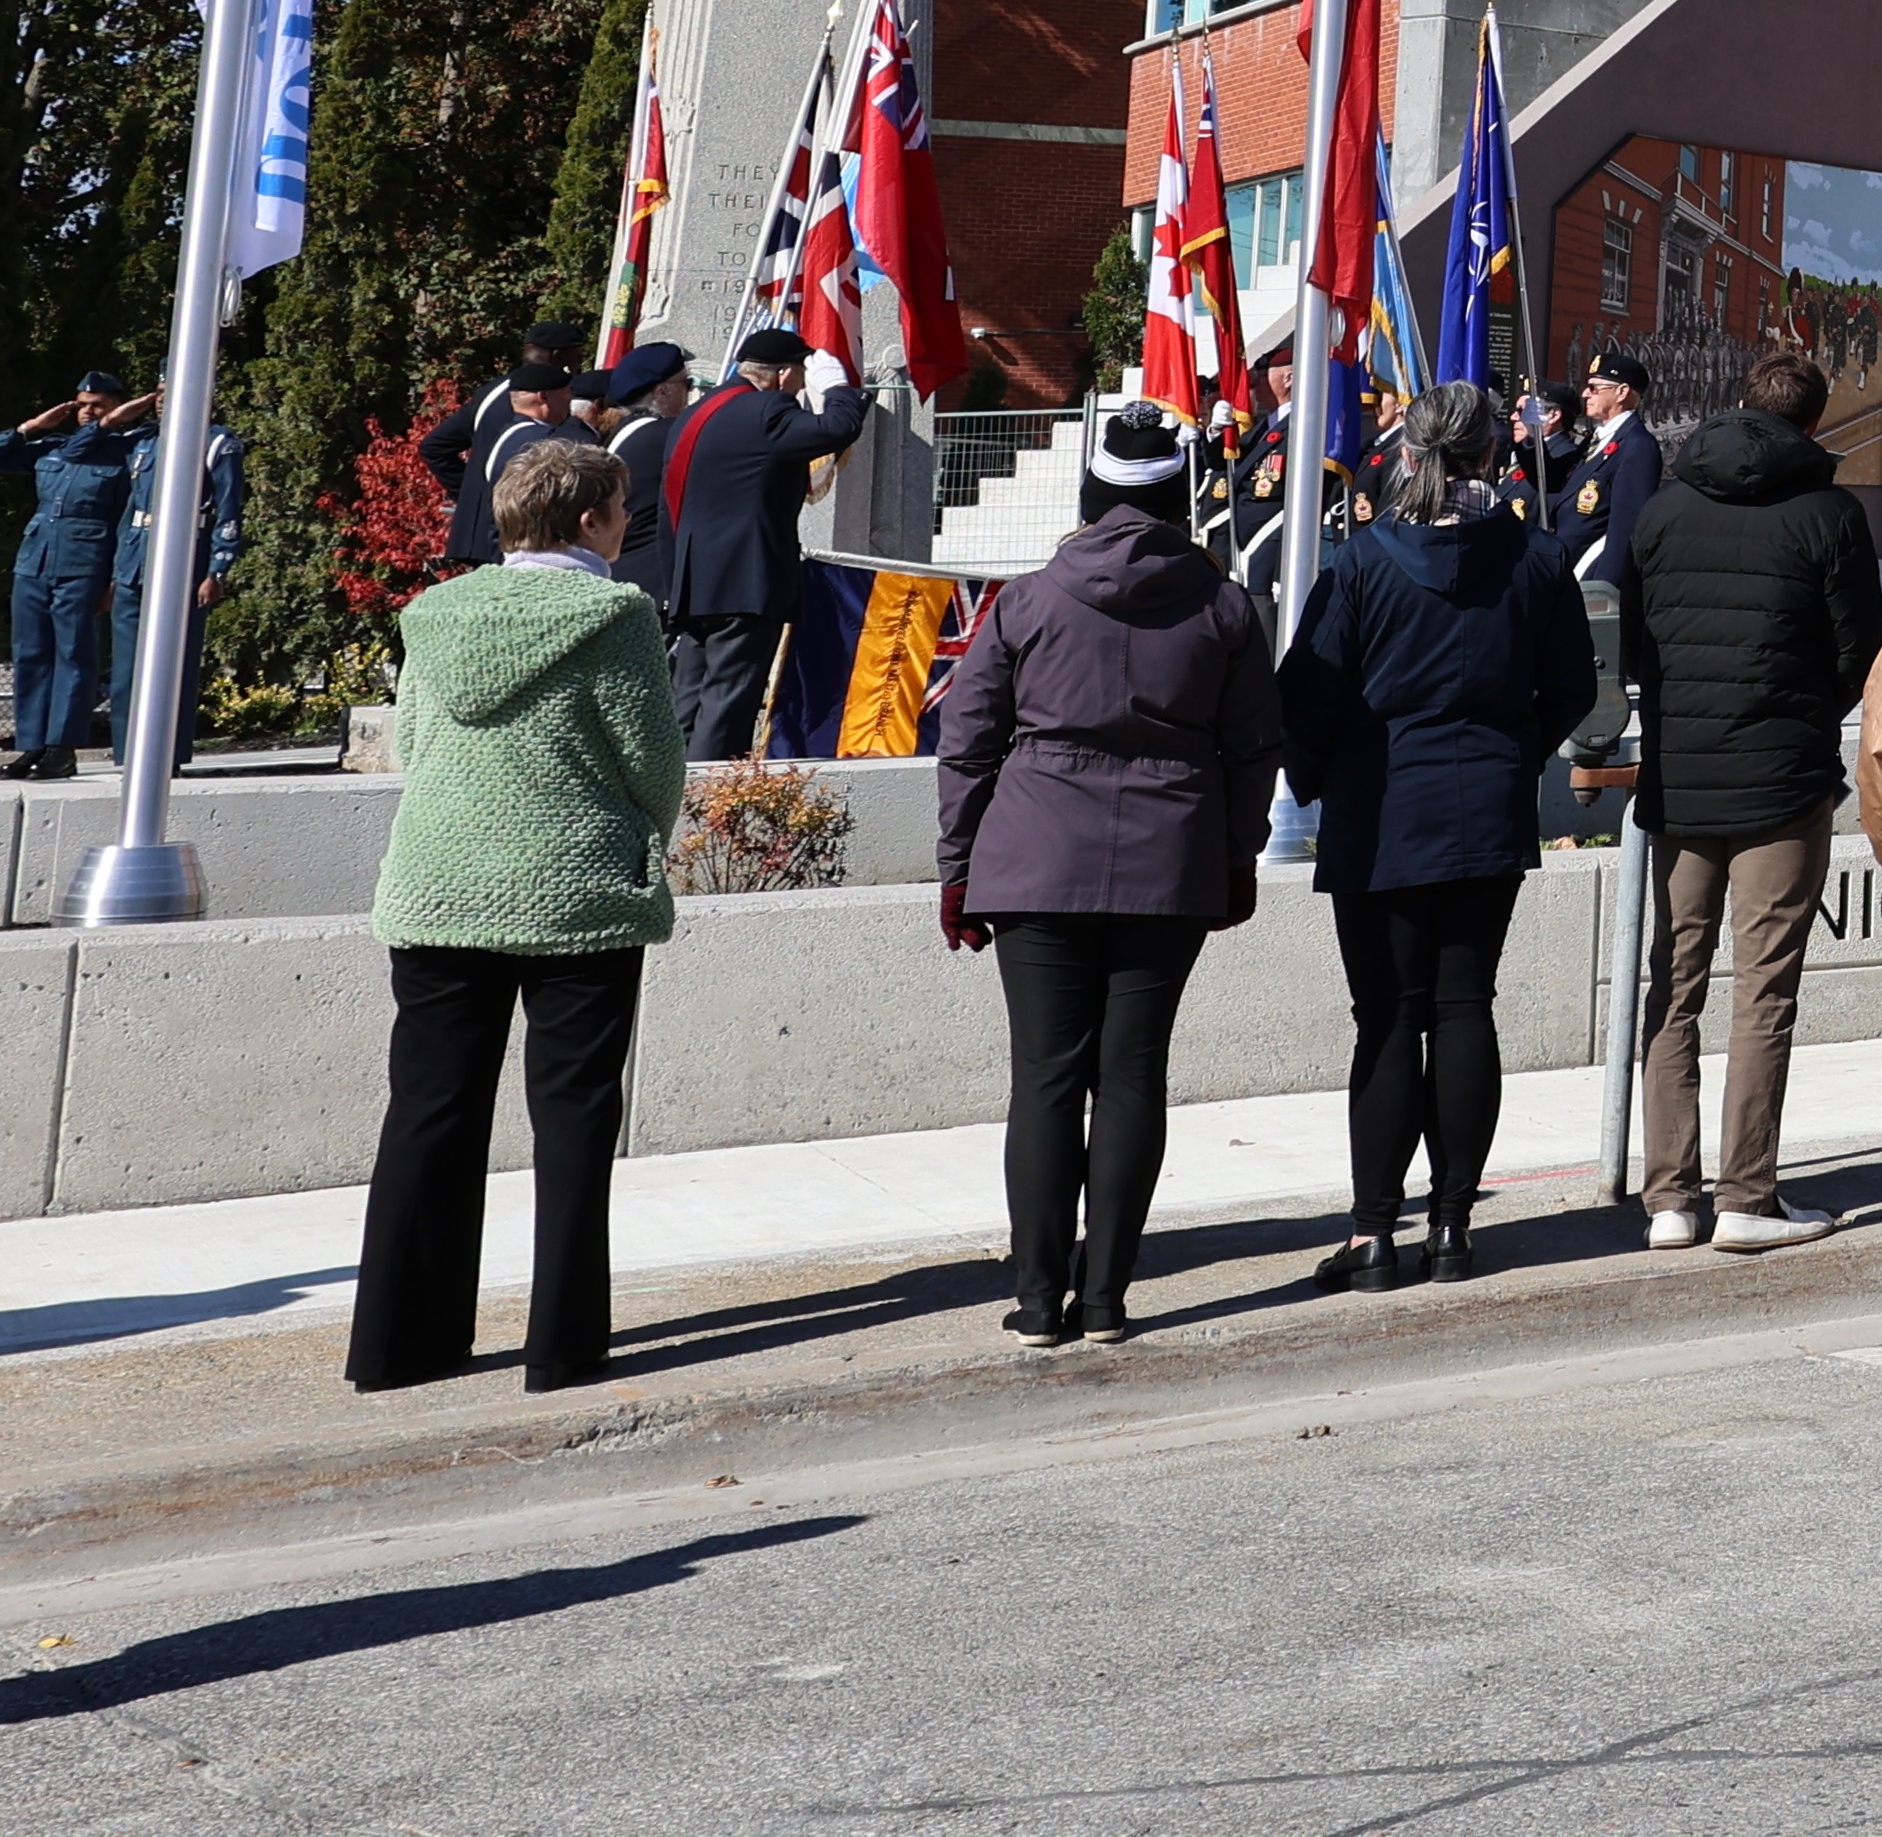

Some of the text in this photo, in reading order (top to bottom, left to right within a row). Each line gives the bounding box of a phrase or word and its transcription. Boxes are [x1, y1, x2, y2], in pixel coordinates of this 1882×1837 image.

[719, 164, 779, 180] THEY
[709, 193, 764, 209] THEI
[732, 223, 761, 237] FO
[717, 252, 746, 266] TO
